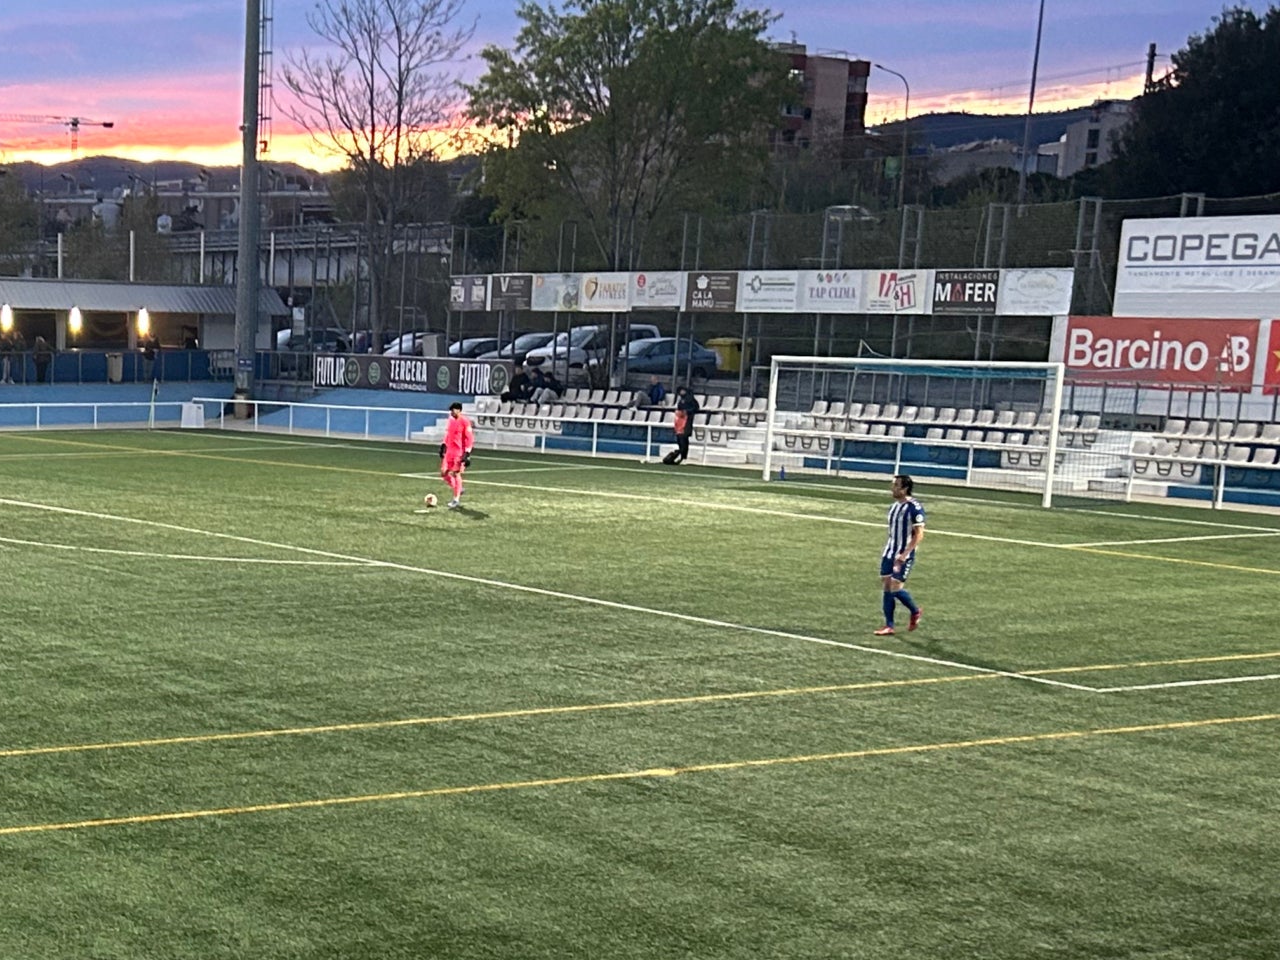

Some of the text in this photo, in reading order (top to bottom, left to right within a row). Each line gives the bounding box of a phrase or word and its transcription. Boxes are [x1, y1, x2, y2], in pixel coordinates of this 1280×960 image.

[936, 272, 998, 281] INSTALACIONES
[1067, 328, 1209, 372] Barcino
[390, 359, 428, 382] TERCERA
